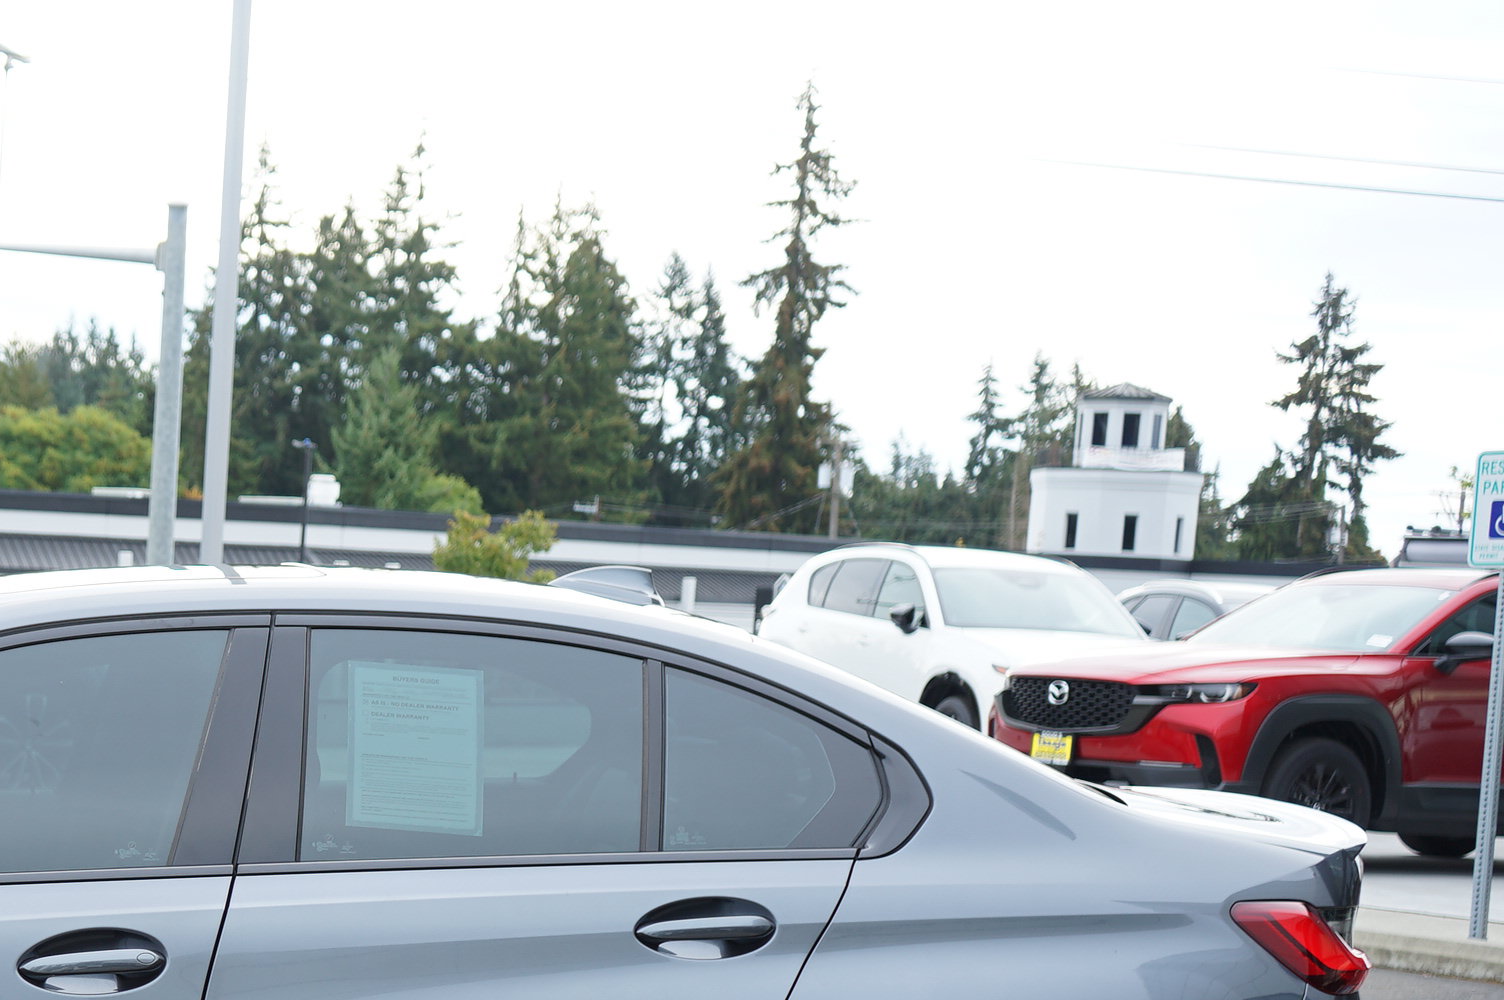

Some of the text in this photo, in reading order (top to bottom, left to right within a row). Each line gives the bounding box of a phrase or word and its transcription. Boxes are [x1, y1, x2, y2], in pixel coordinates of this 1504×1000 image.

[392, 676, 441, 685] BUYERS GUIDE
[426, 704, 460, 712] WARRANTY
[395, 713, 430, 721] WARRANTY
